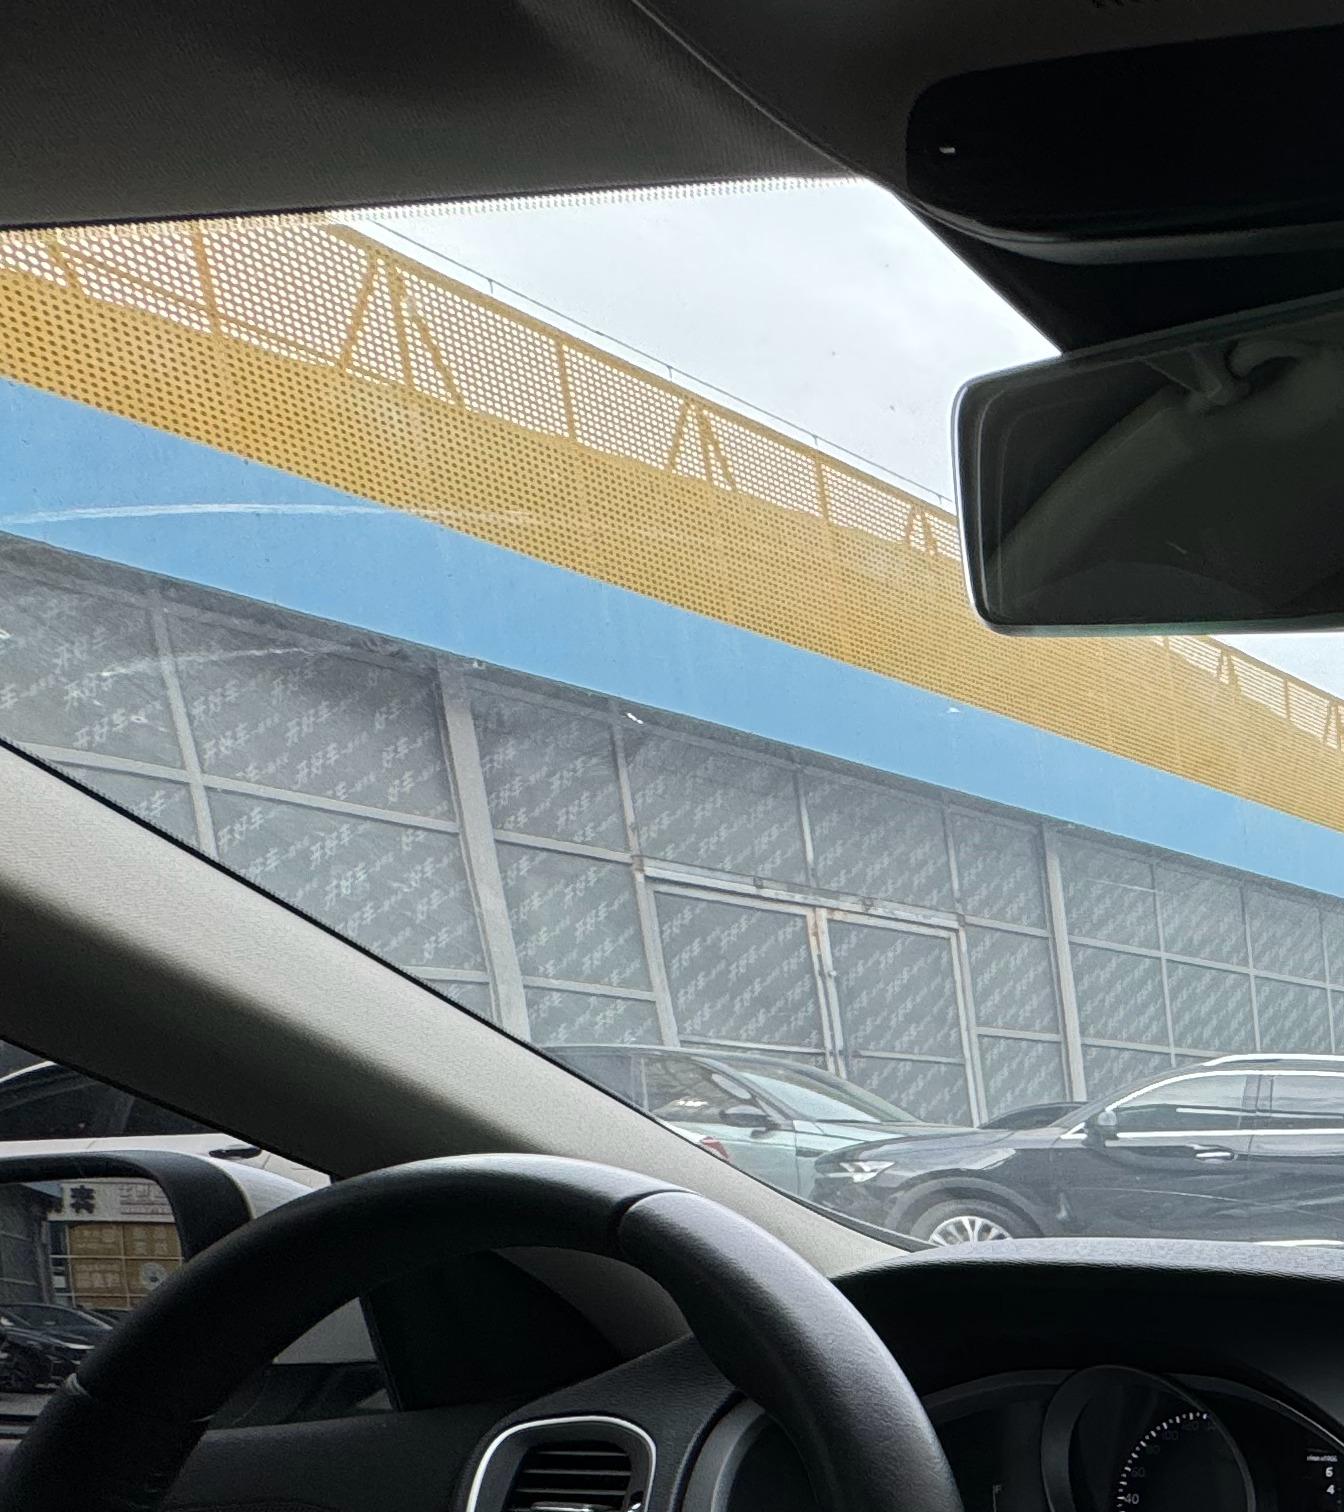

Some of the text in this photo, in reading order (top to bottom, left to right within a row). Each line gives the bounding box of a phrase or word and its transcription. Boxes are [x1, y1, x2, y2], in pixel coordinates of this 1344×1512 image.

[1325, 1467, 1333, 1478] 6
[1326, 1484, 1336, 1495] 4
[1125, 1493, 1140, 1504] 40
